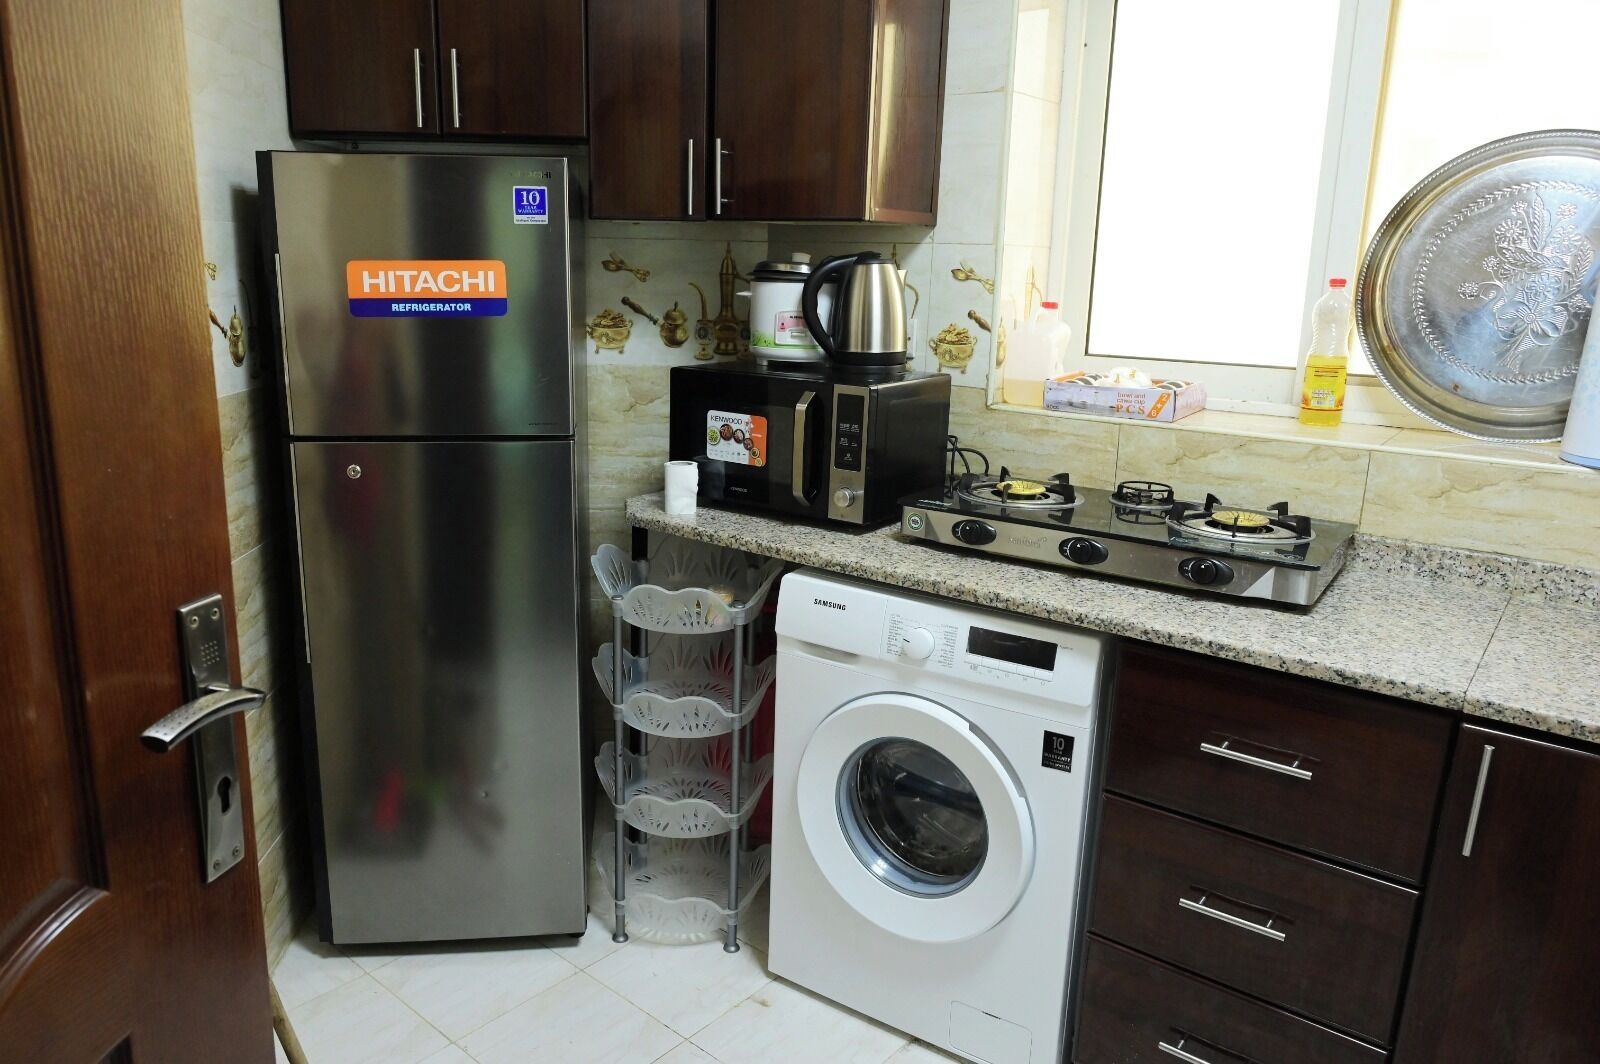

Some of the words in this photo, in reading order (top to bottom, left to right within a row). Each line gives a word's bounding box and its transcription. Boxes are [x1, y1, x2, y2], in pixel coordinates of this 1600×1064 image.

[520, 190, 540, 206] 10
[362, 270, 496, 293] HITACHI
[391, 303, 472, 312] REFRIGERATOR
[710, 415, 743, 425] KENWOOD
[813, 598, 847, 611] SAMSUNG
[1052, 736, 1065, 751] 10
